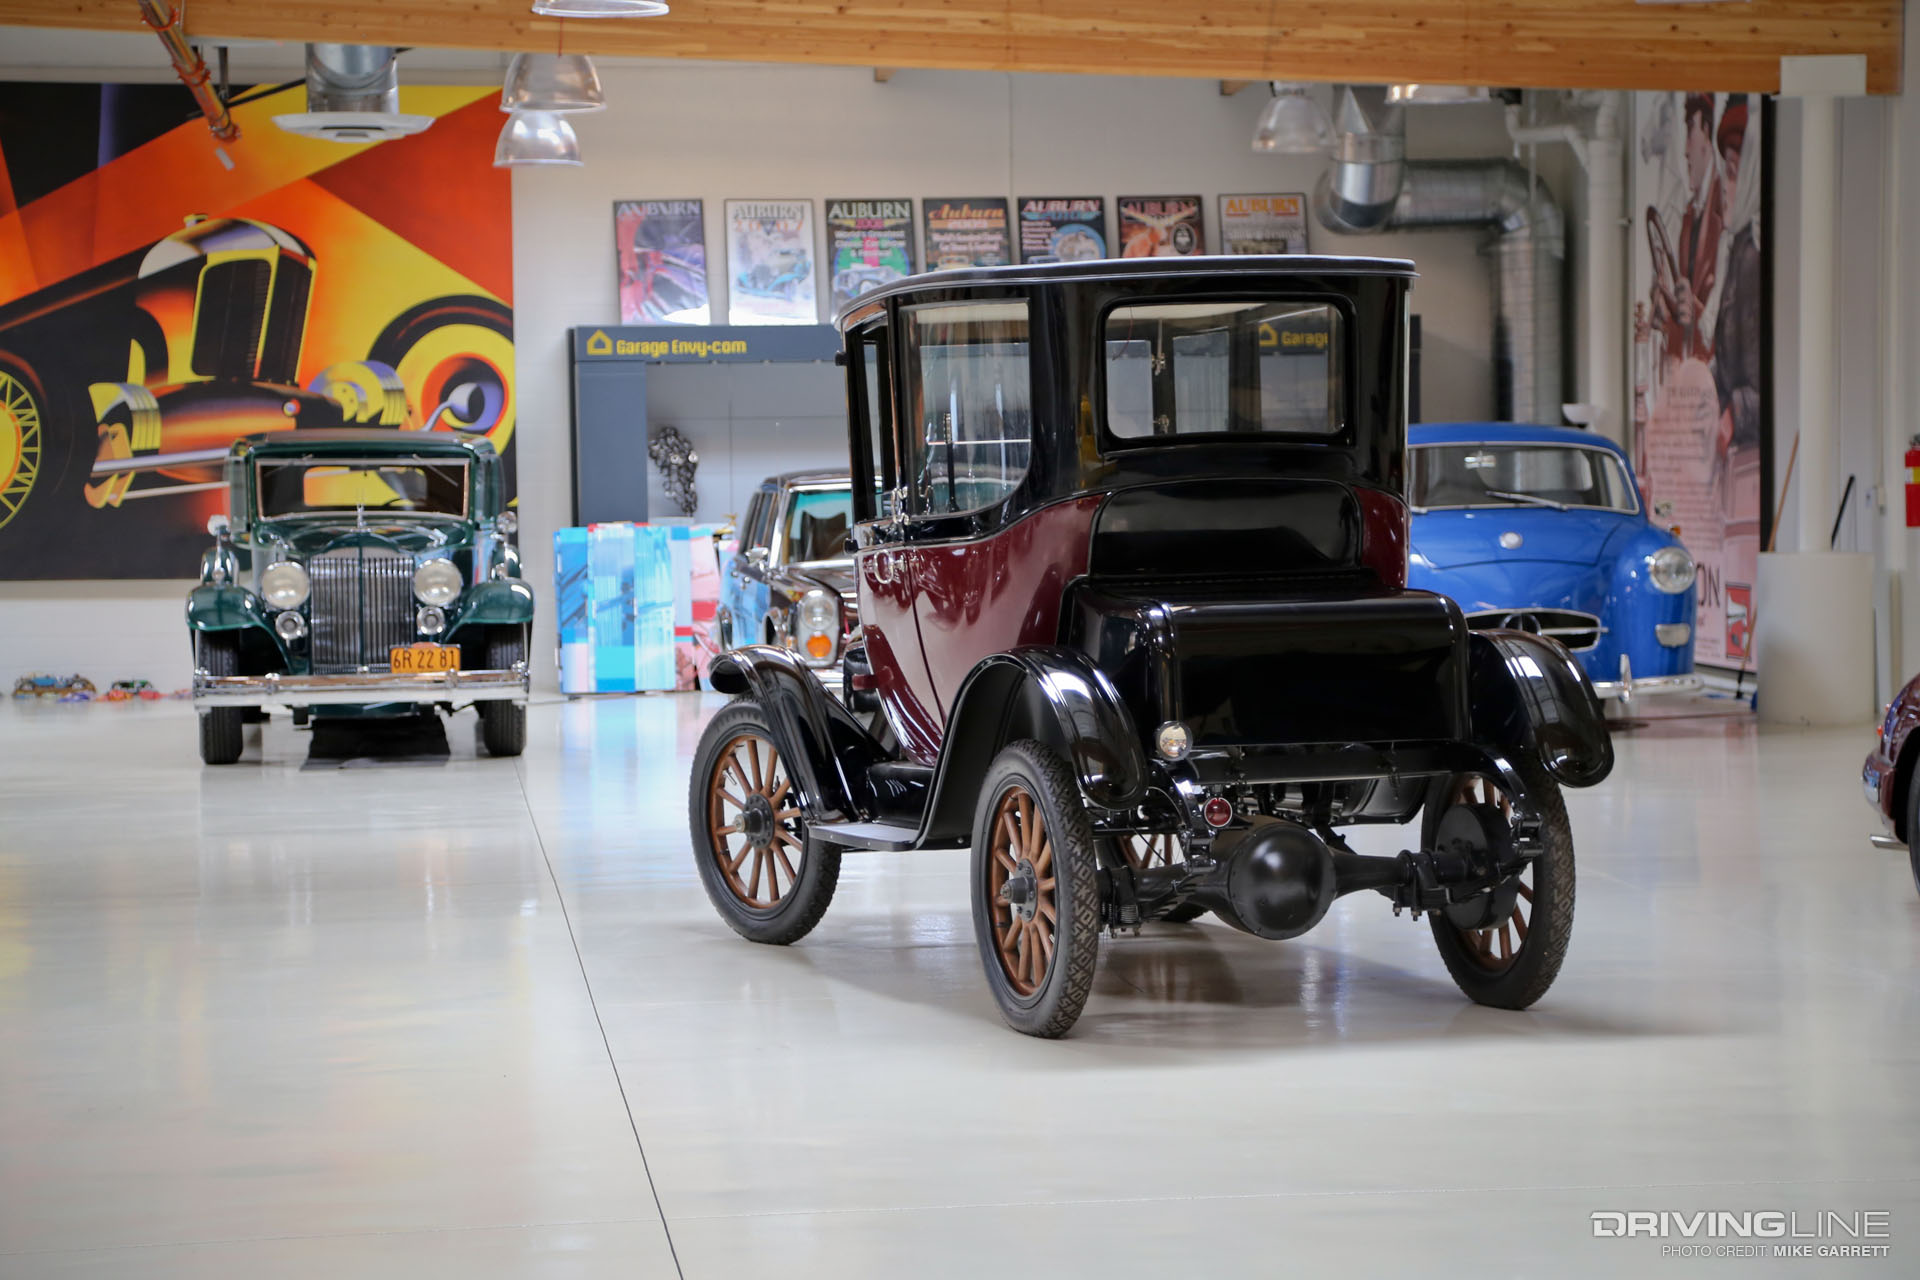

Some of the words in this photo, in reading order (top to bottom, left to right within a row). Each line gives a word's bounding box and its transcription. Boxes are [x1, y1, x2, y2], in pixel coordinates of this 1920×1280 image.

[828, 202, 911, 218] AUBURN
[1023, 199, 1100, 213] AUBURN
[616, 339, 669, 358] Garage
[393, 650, 413, 669] 6R
[417, 650, 434, 669] 22
